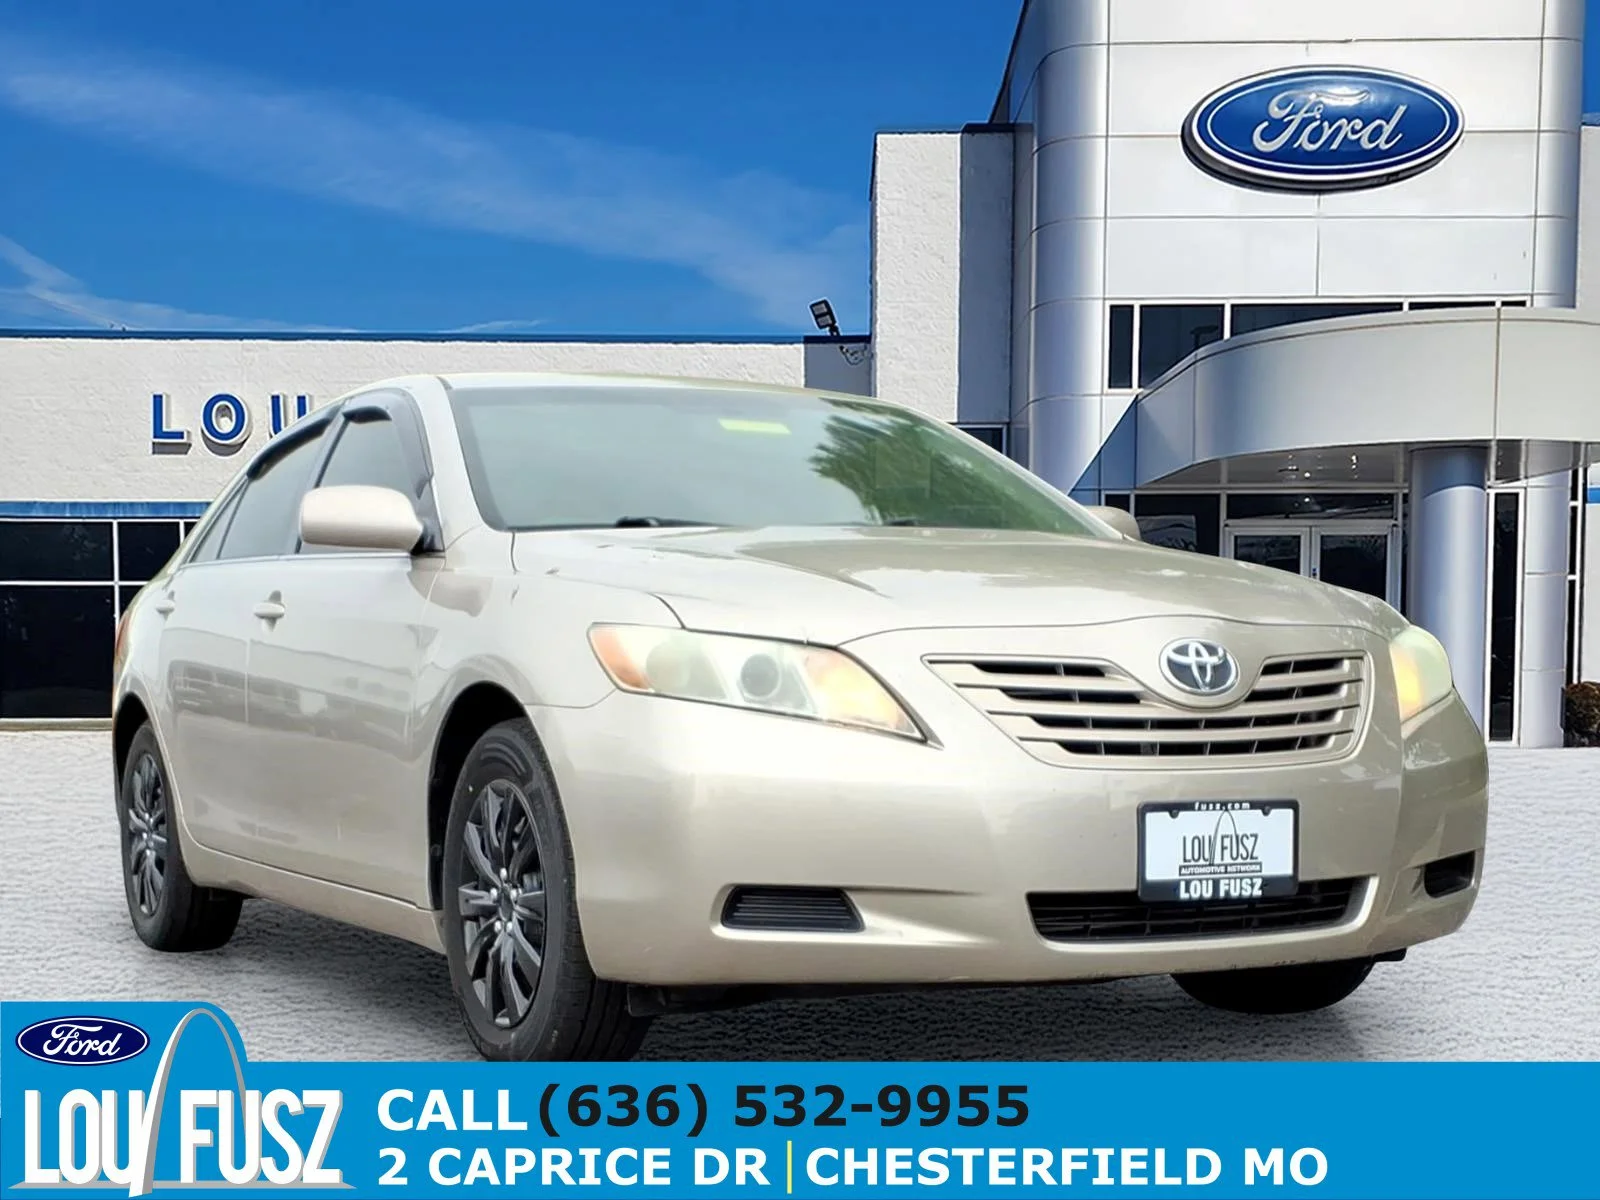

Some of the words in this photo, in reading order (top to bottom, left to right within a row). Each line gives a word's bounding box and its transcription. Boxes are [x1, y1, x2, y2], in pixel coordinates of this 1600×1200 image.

[1253, 88, 1407, 152] Ford
[1194, 802, 1250, 811] fusz.com
[1183, 835, 1212, 863] LOU
[1220, 833, 1259, 862] FUSZ
[1180, 866, 1225, 875] AUTOMOTIVE
[1227, 864, 1261, 873] NETWORK
[1180, 879, 1213, 899] LOU
[1219, 878, 1263, 898] FUSZ
